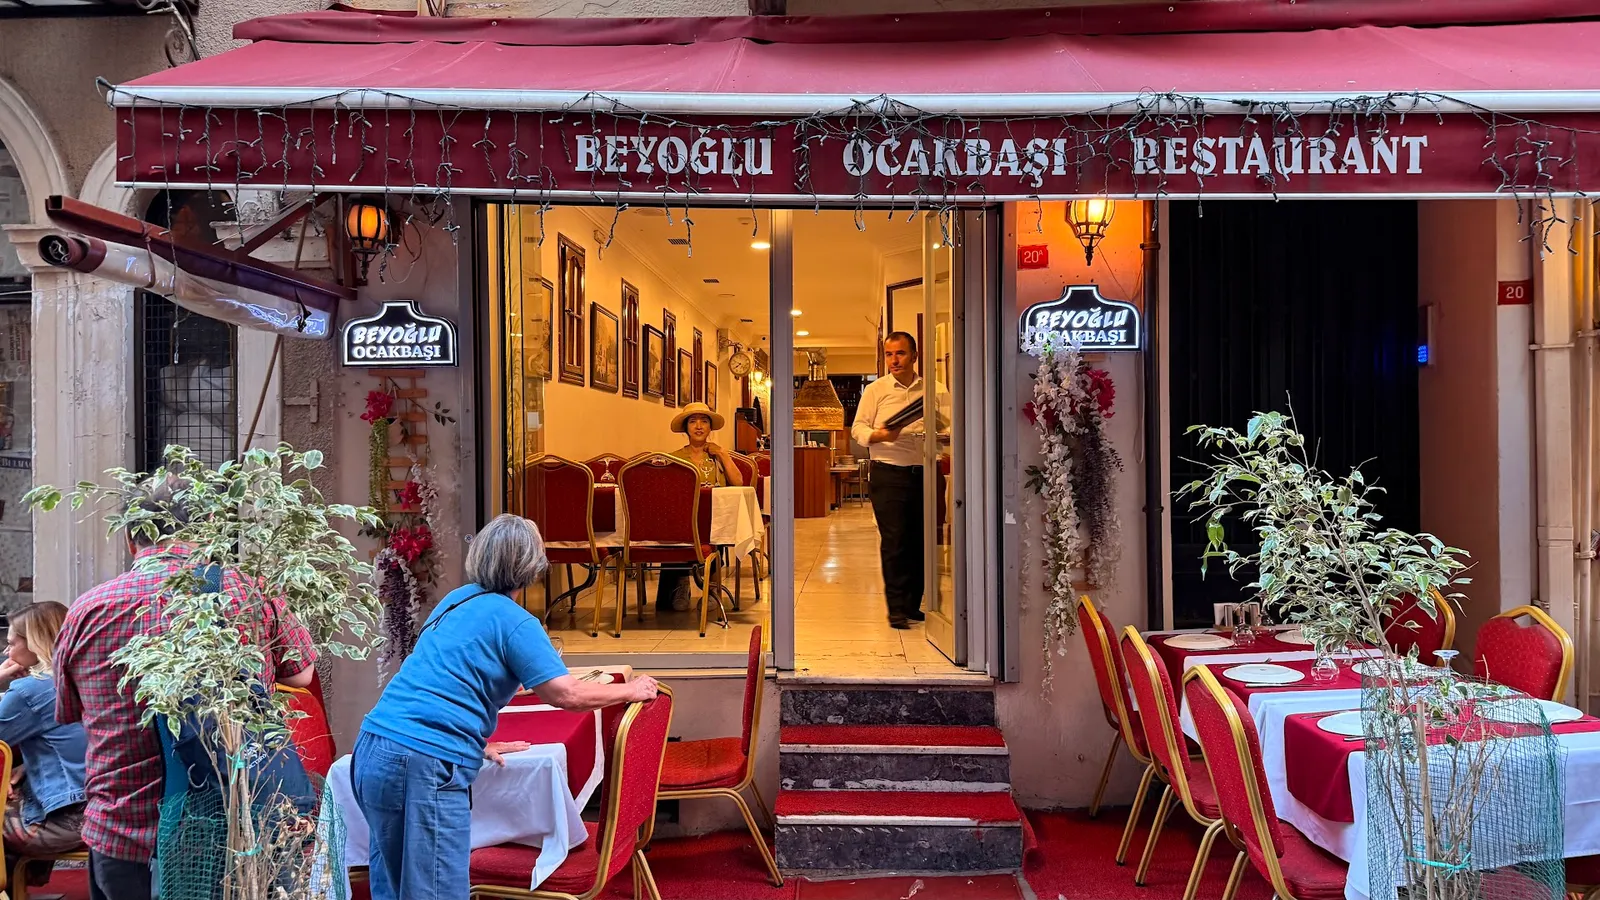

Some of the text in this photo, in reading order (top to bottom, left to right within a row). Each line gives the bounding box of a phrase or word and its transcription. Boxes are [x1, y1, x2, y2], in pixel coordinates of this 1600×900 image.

[574, 128, 1428, 188] BEYOĞLU OCAKBAŞI RESTAURANT
[1505, 286, 1524, 299] 20
[1035, 307, 1129, 329] BEYOĞLU
[352, 322, 442, 344] BEYOĞLU
[352, 345, 441, 361] OCAKBAŞI
